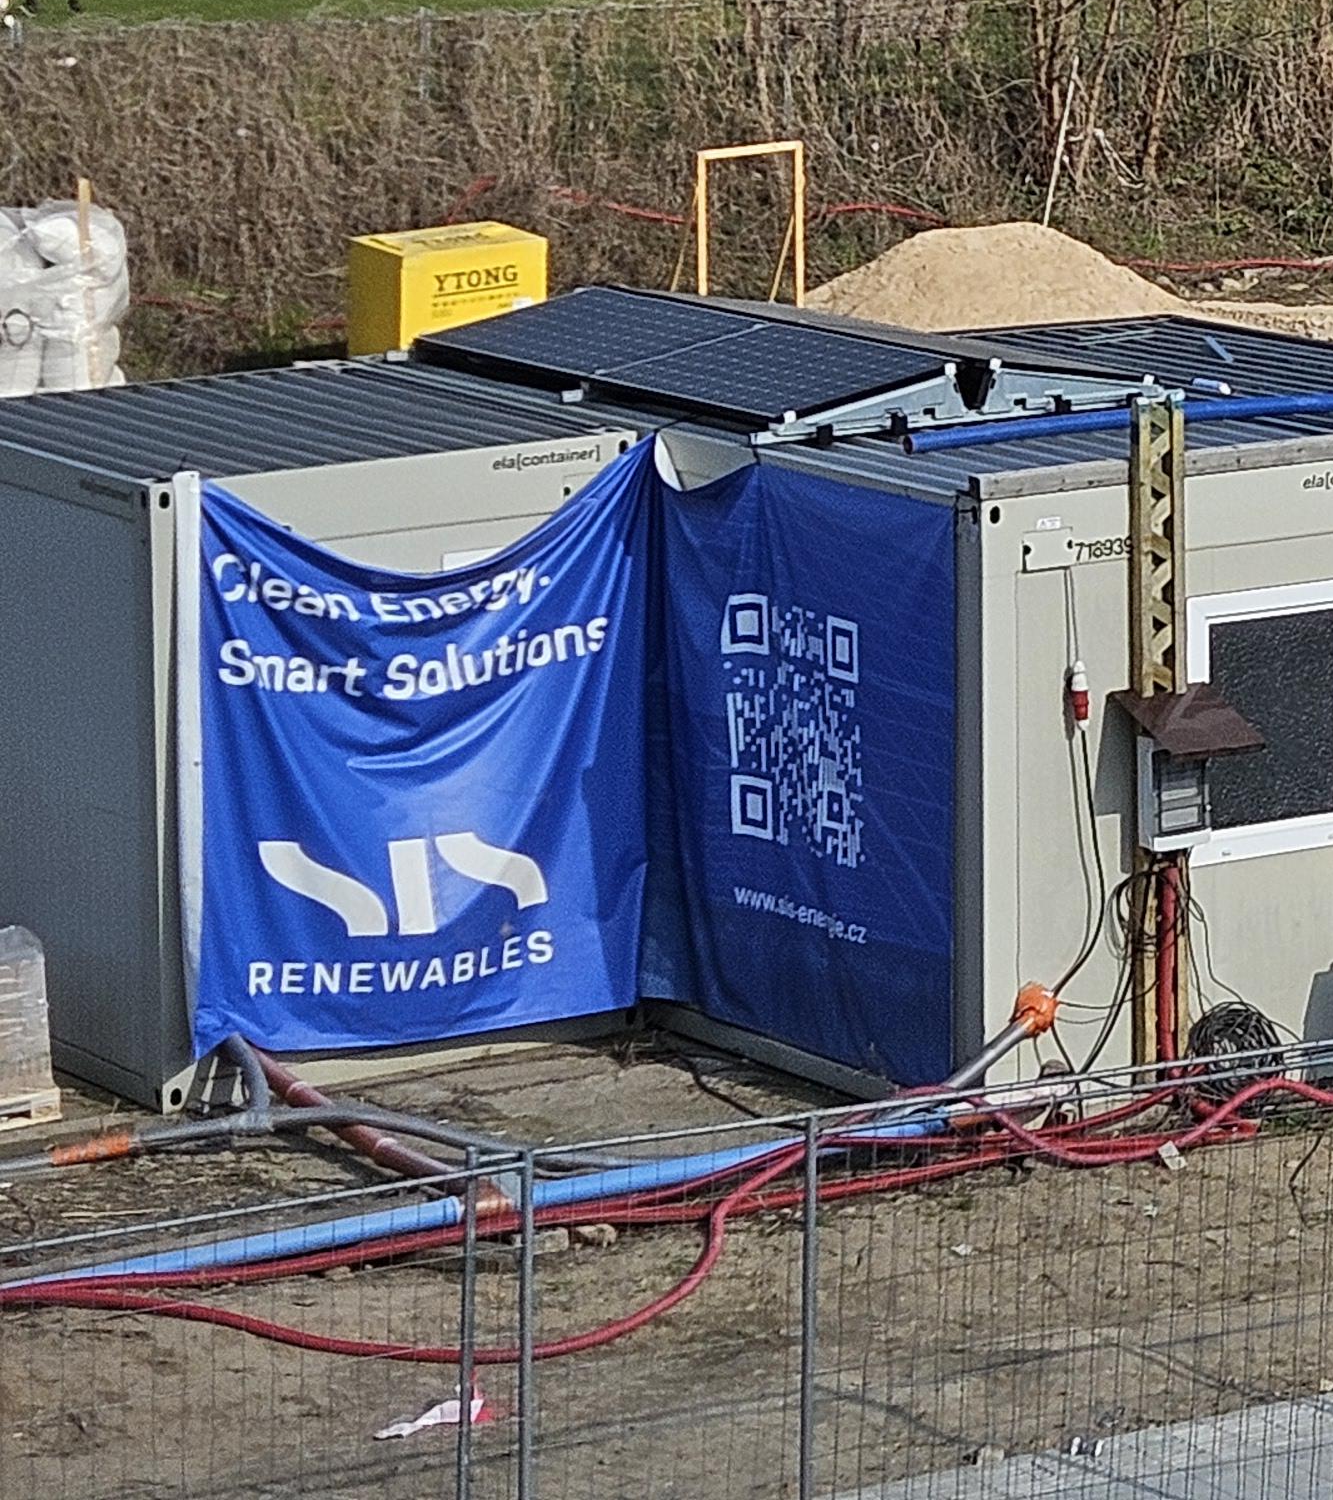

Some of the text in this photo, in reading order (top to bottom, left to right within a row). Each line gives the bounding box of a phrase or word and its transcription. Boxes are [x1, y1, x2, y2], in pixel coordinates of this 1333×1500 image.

[433, 264, 518, 292] YTONG
[212, 553, 552, 623] Clean Energy.
[218, 616, 609, 701] Smart Solutions
[248, 930, 554, 997] RENEWABLES
